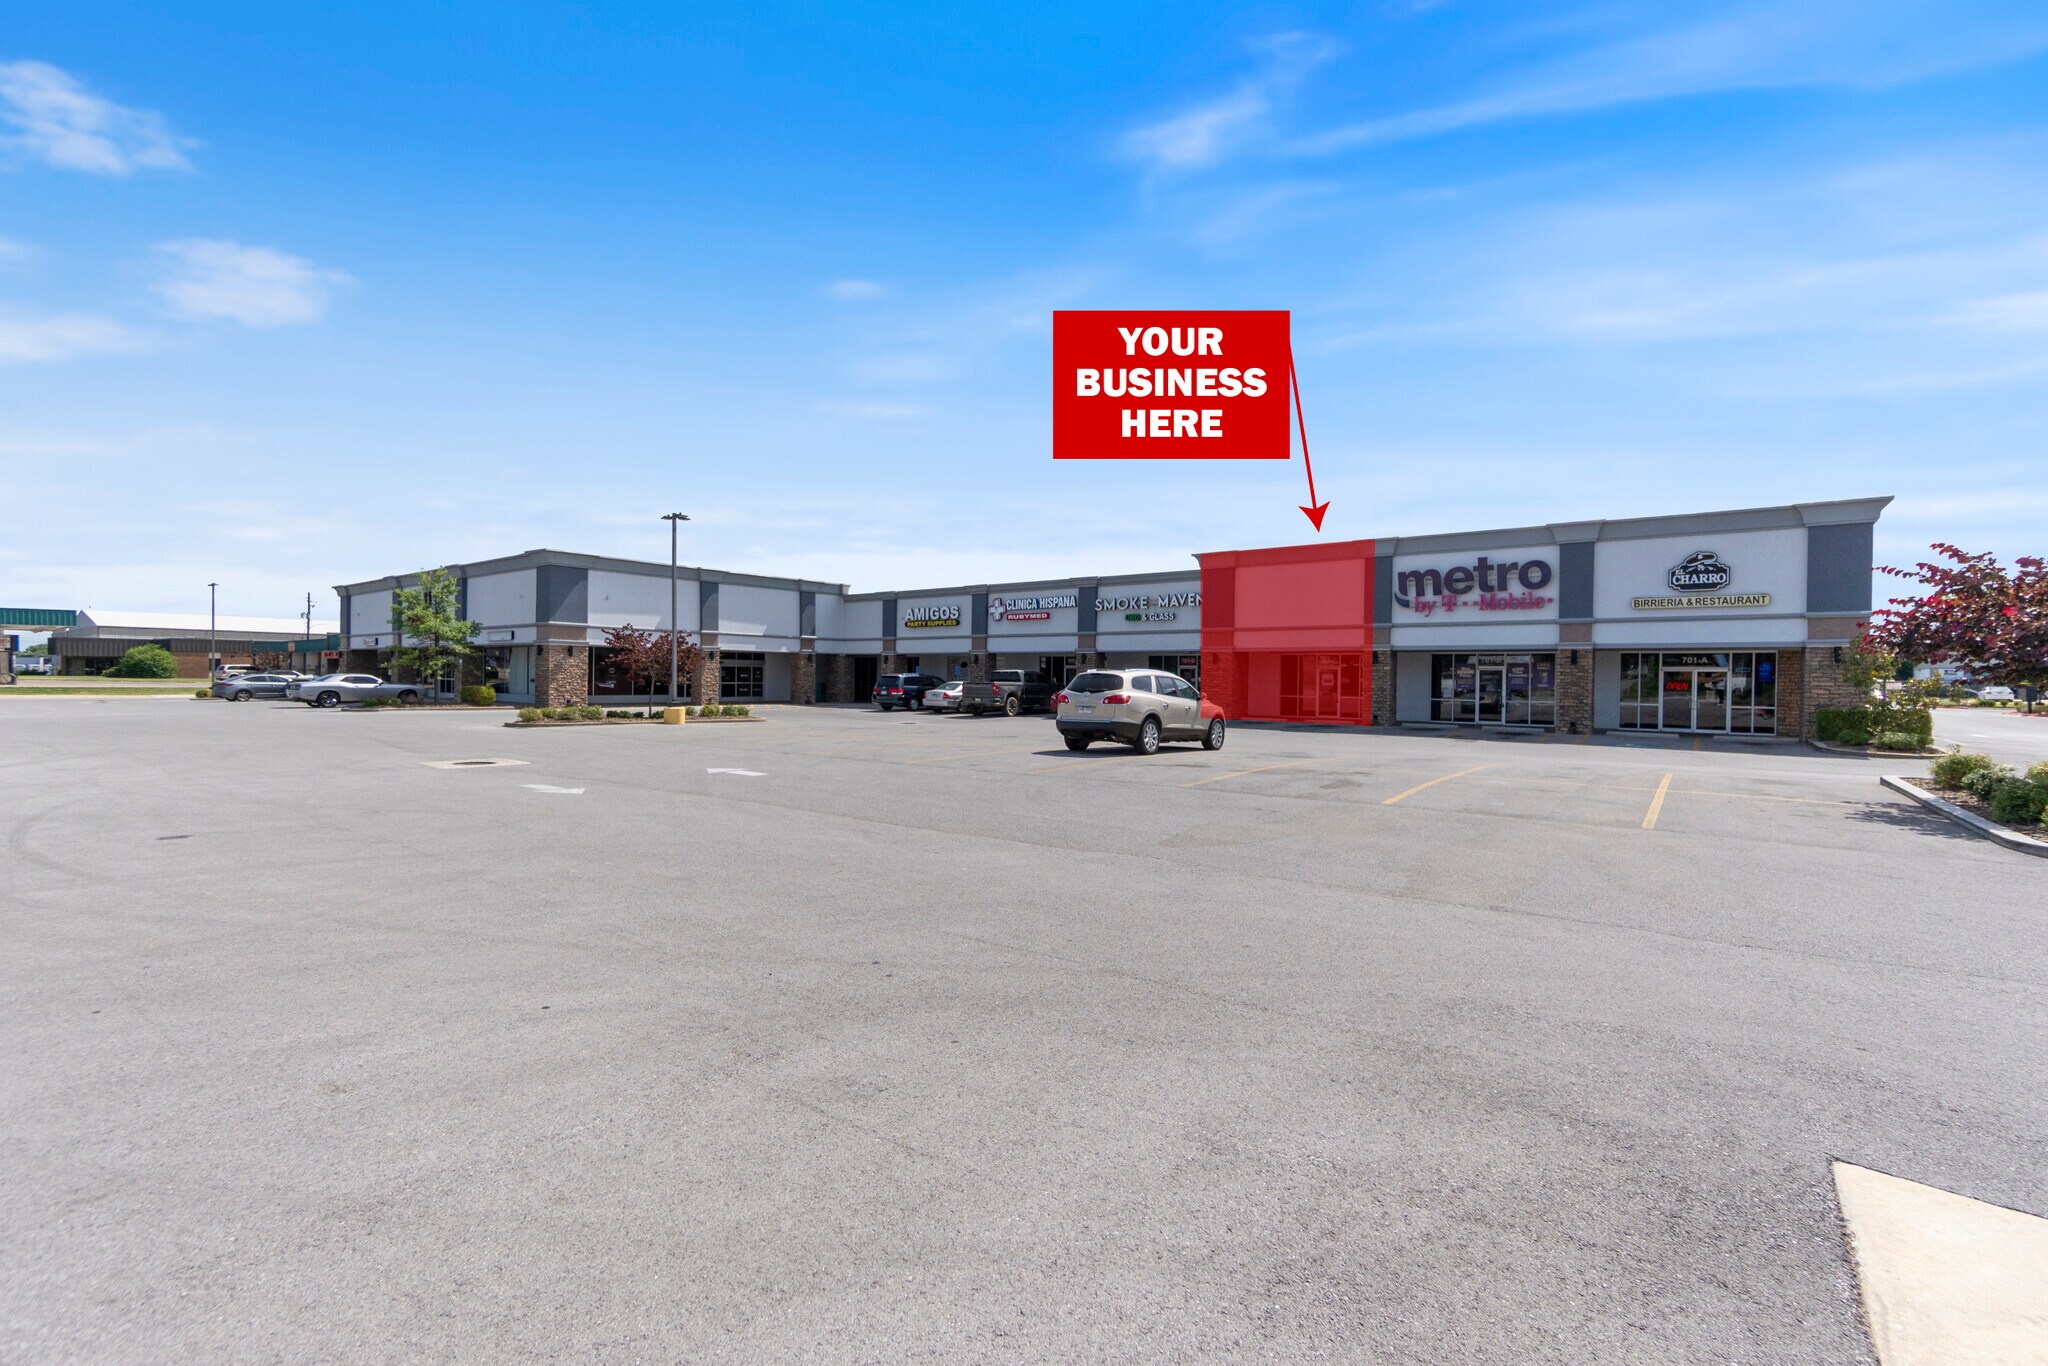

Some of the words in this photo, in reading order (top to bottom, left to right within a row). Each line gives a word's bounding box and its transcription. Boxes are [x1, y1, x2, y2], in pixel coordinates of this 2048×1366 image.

[1397, 556, 1552, 597] metro
[1672, 573, 1726, 585] CHARRO
[1006, 599, 1039, 611] CLINICA
[1039, 595, 1077, 608] HISPANA
[1095, 596, 1149, 612] SMOKE
[1414, 596, 1436, 617] by
[1633, 599, 1684, 608] BIRRIERIA
[1686, 598, 1694, 607] &
[1695, 595, 1768, 606] RESTAURANT
[905, 606, 960, 621] AMIGOS
[1149, 612, 1175, 620] GLASS
[907, 620, 926, 628] PARTY
[927, 619, 957, 627] SUPPLIES
[1682, 656, 1709, 664] 701-A
[1665, 682, 1690, 690] OPEN
